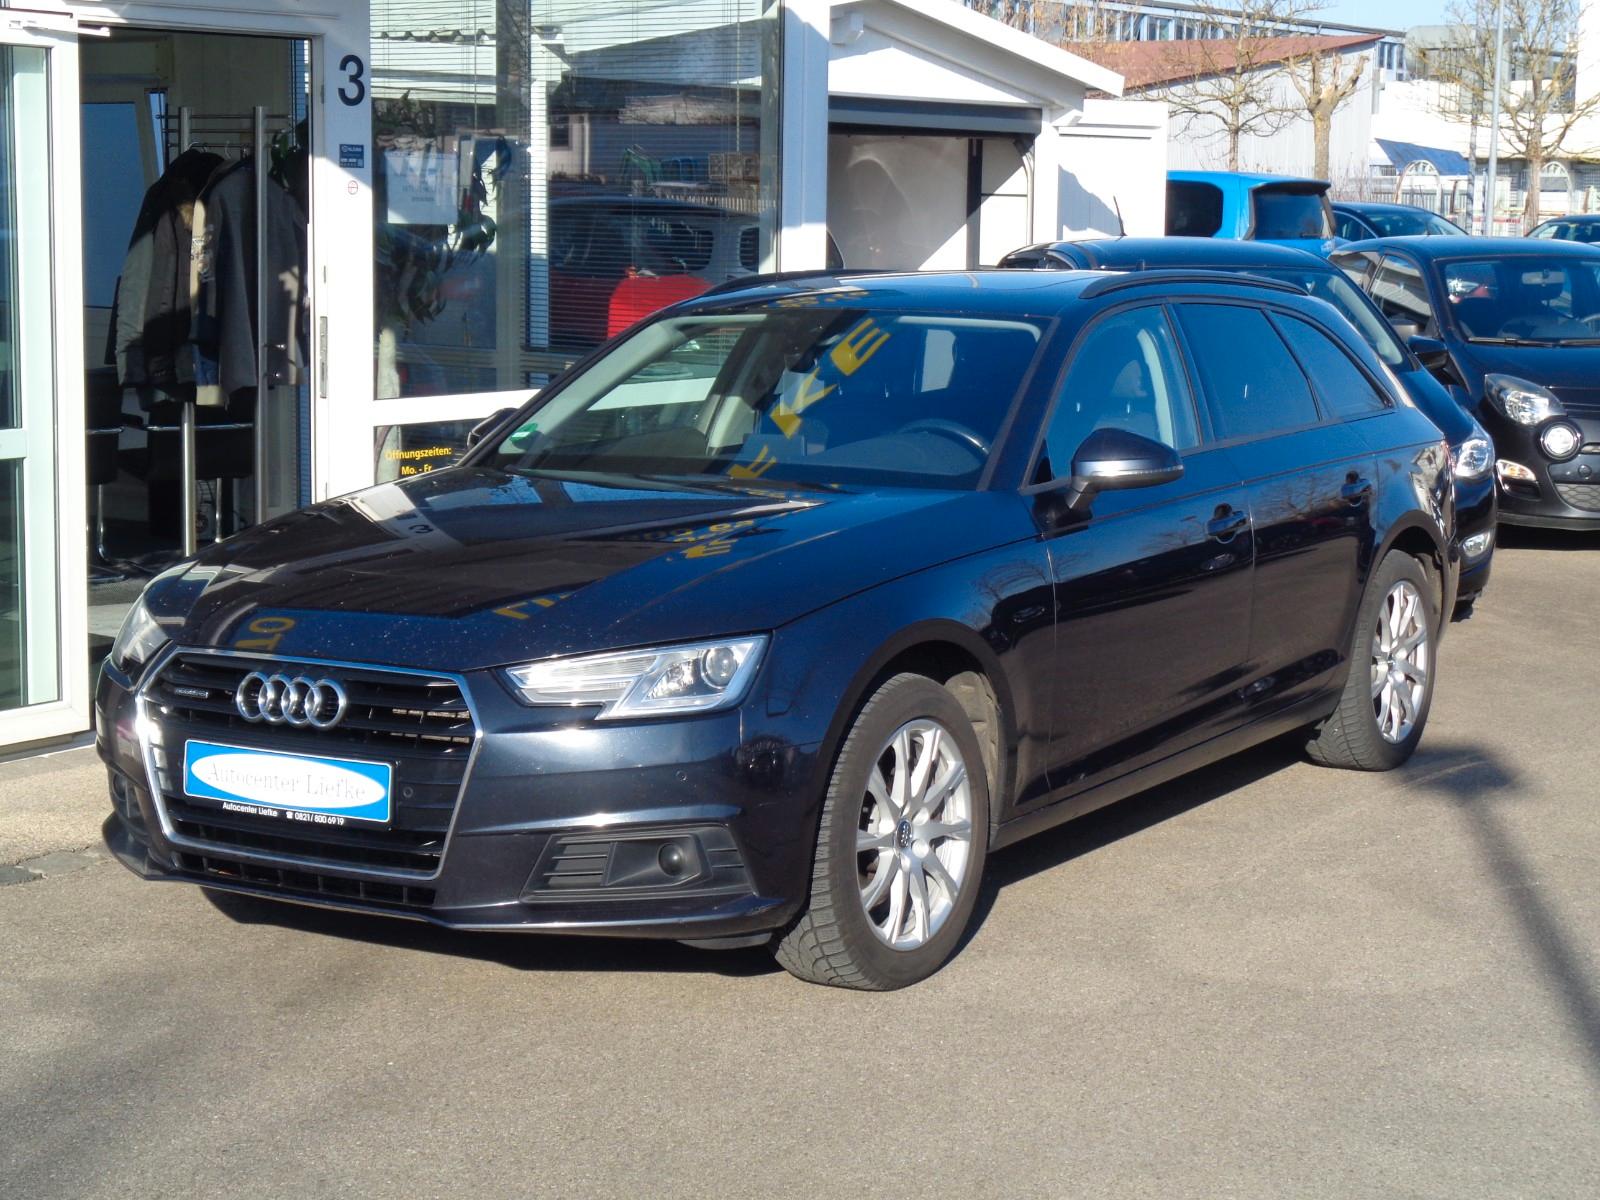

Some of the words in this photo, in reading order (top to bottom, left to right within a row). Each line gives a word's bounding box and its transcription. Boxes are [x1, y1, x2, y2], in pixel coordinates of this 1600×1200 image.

[338, 54, 365, 106] 3
[401, 466, 417, 475] Mo.
[222, 801, 257, 815] Autocenter
